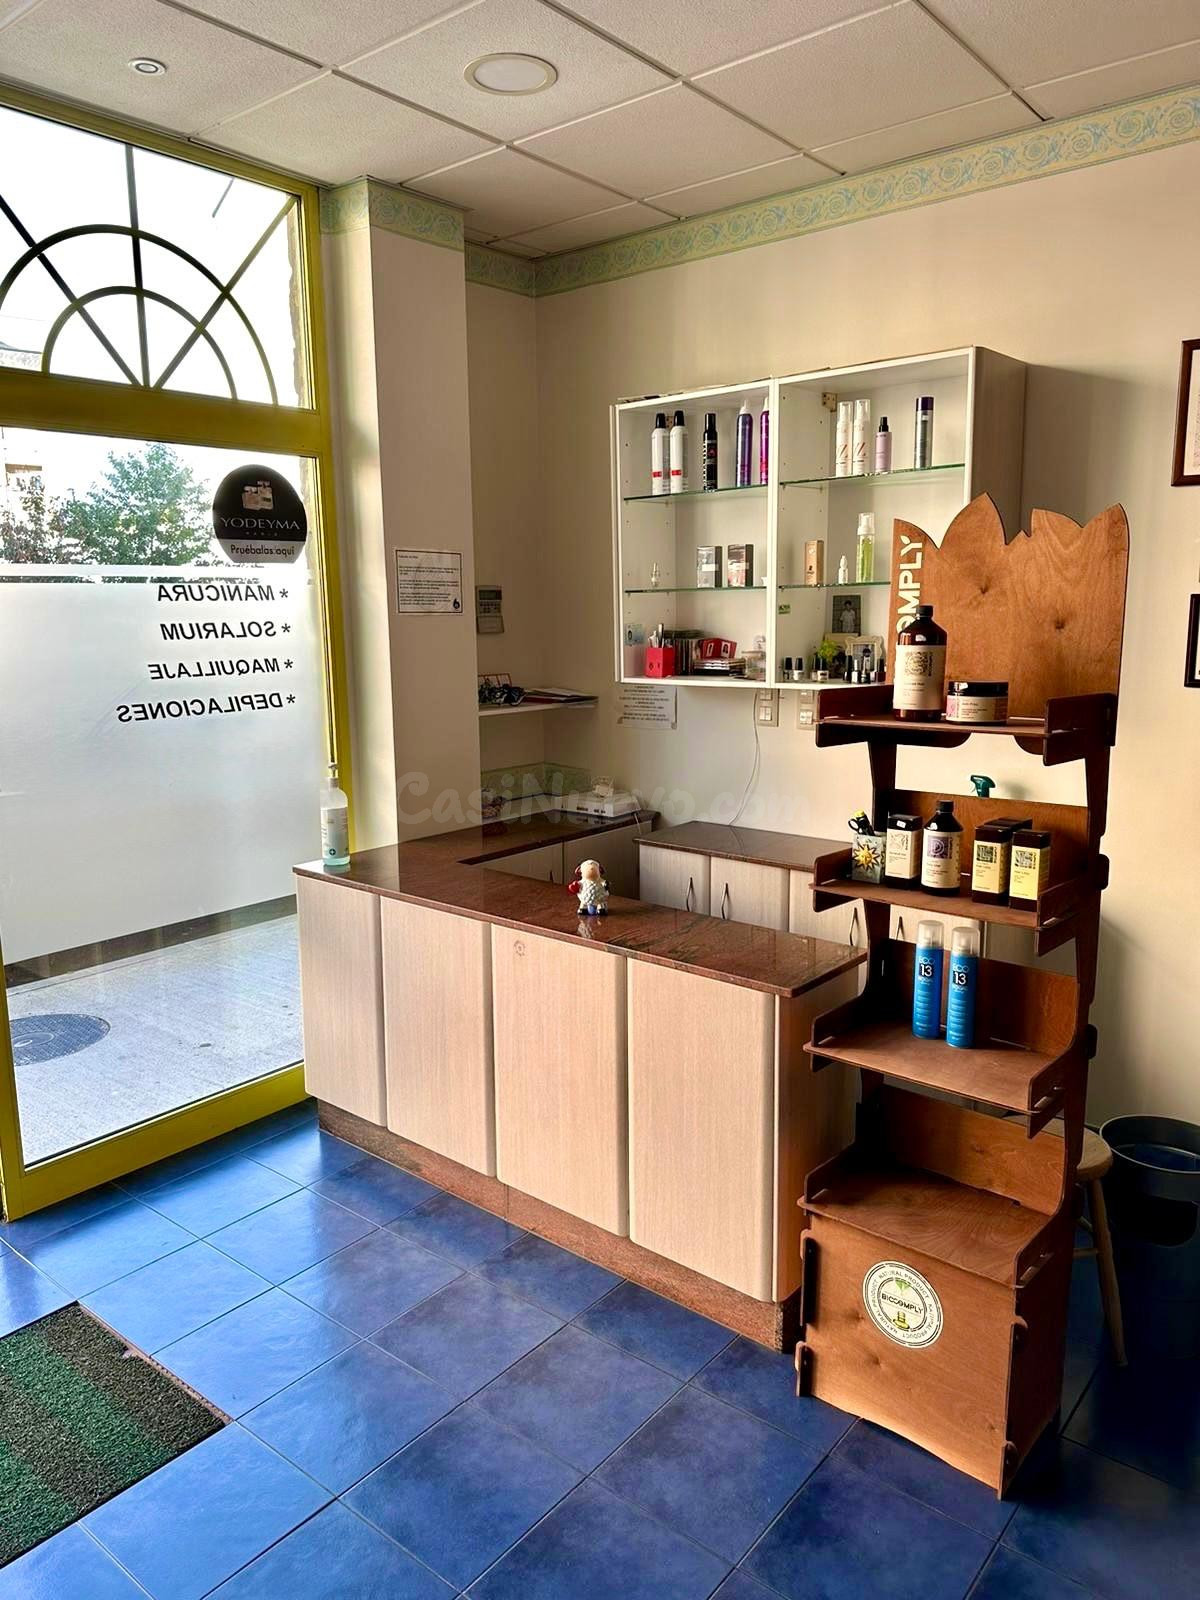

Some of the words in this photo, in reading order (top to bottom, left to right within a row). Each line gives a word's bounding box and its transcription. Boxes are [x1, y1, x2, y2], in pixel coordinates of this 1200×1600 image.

[220, 517, 301, 530] YODEYMA
[920, 963, 932, 977] 13
[954, 971, 966, 985] 13
